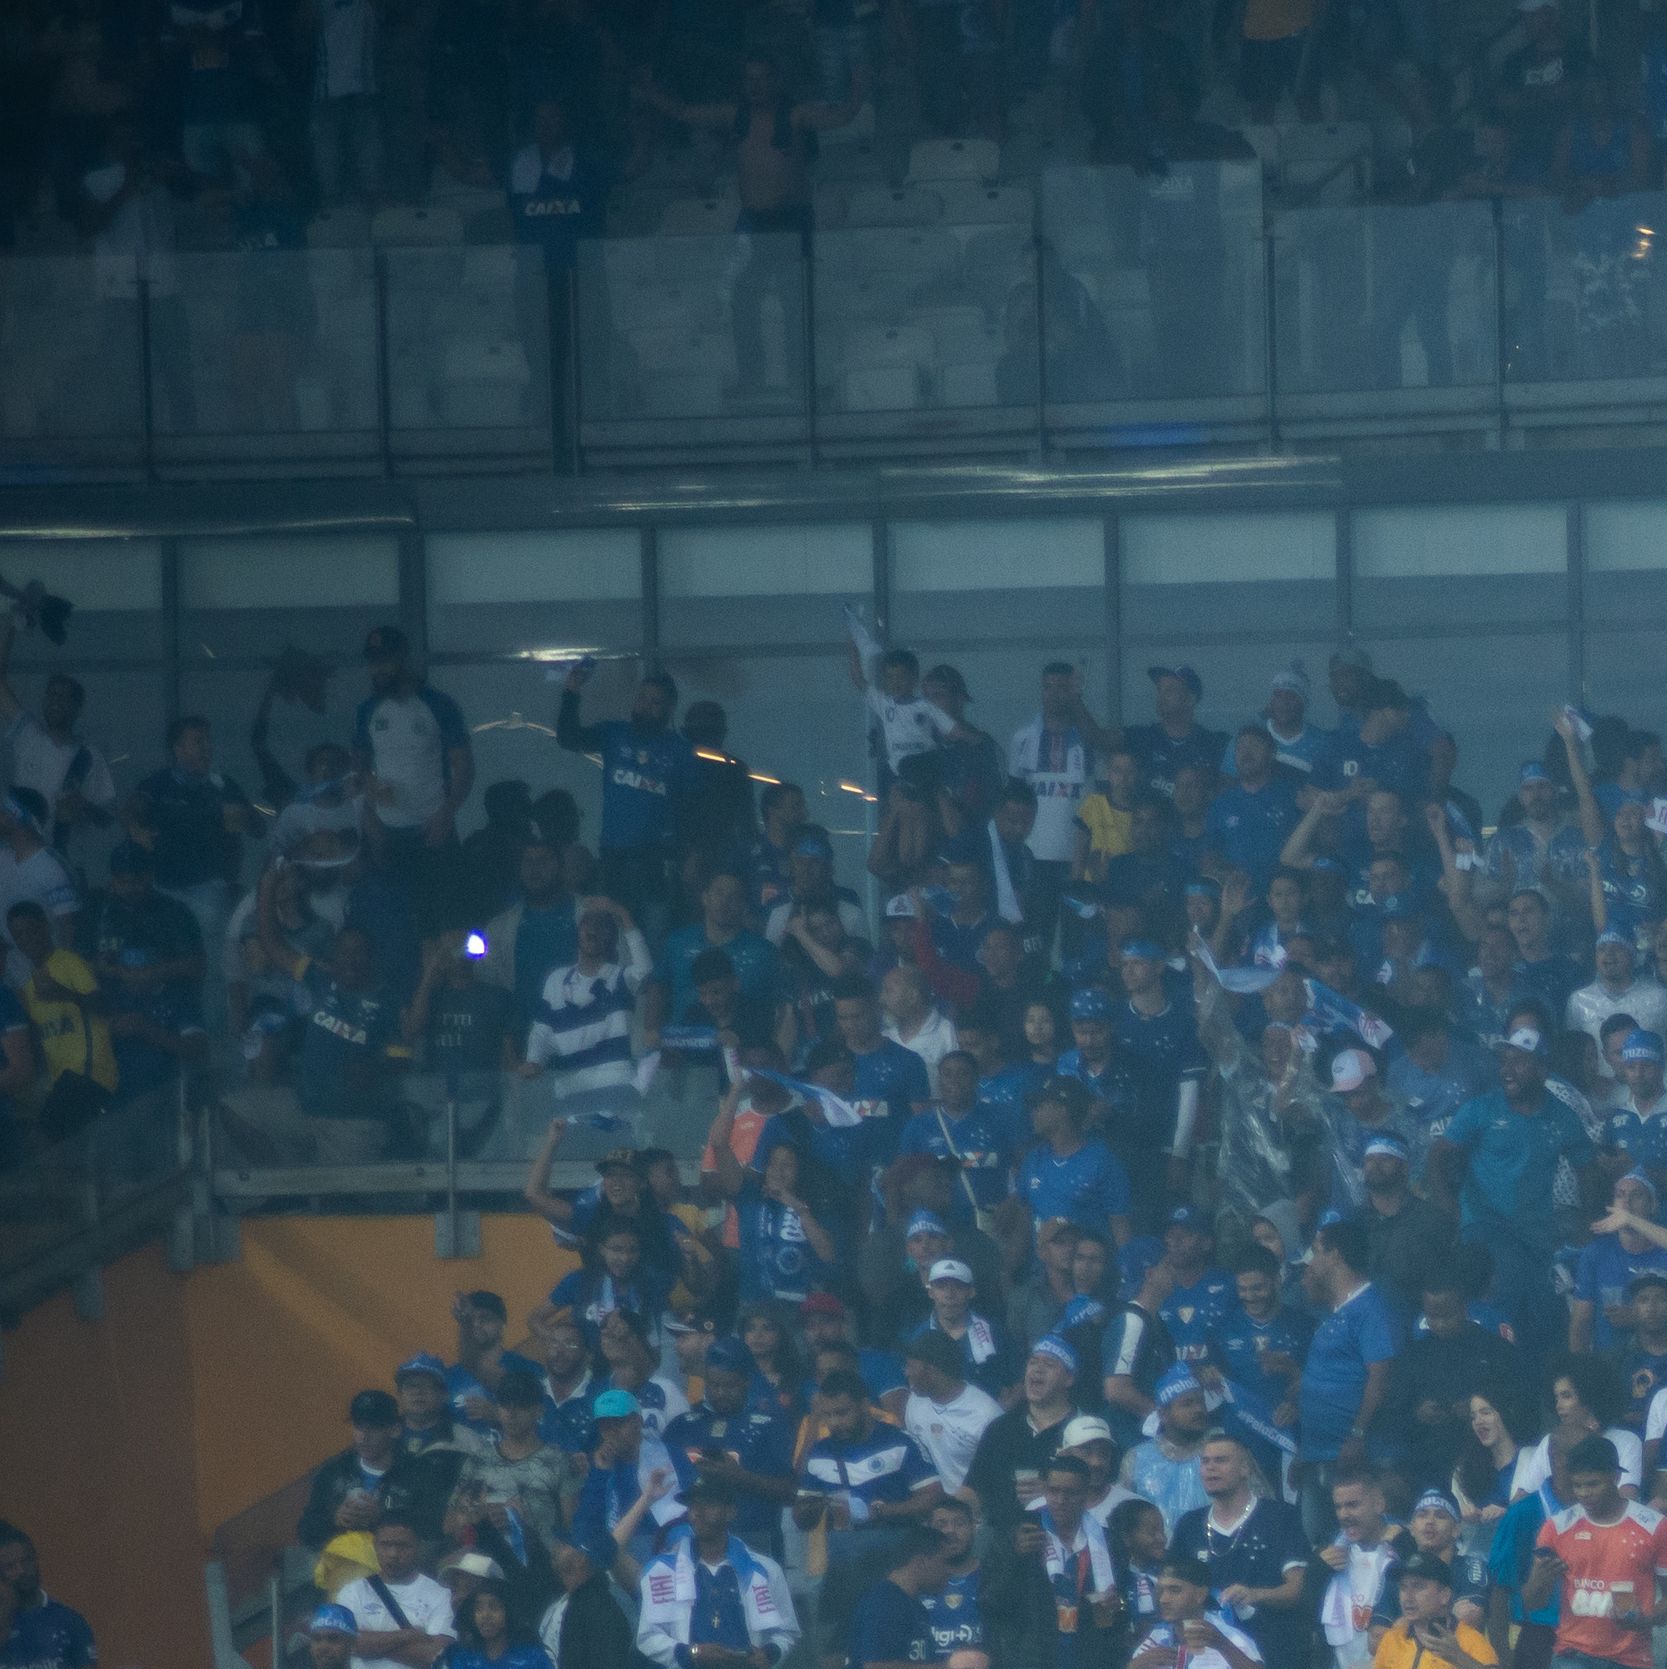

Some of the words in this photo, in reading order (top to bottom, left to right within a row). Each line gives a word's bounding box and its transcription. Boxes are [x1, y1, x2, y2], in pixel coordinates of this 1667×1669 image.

[524, 199, 582, 218] CAIXA
[612, 768, 667, 797] CAIXA
[312, 1010, 367, 1045] CAIXA
[648, 1573, 677, 1605] FIAT
